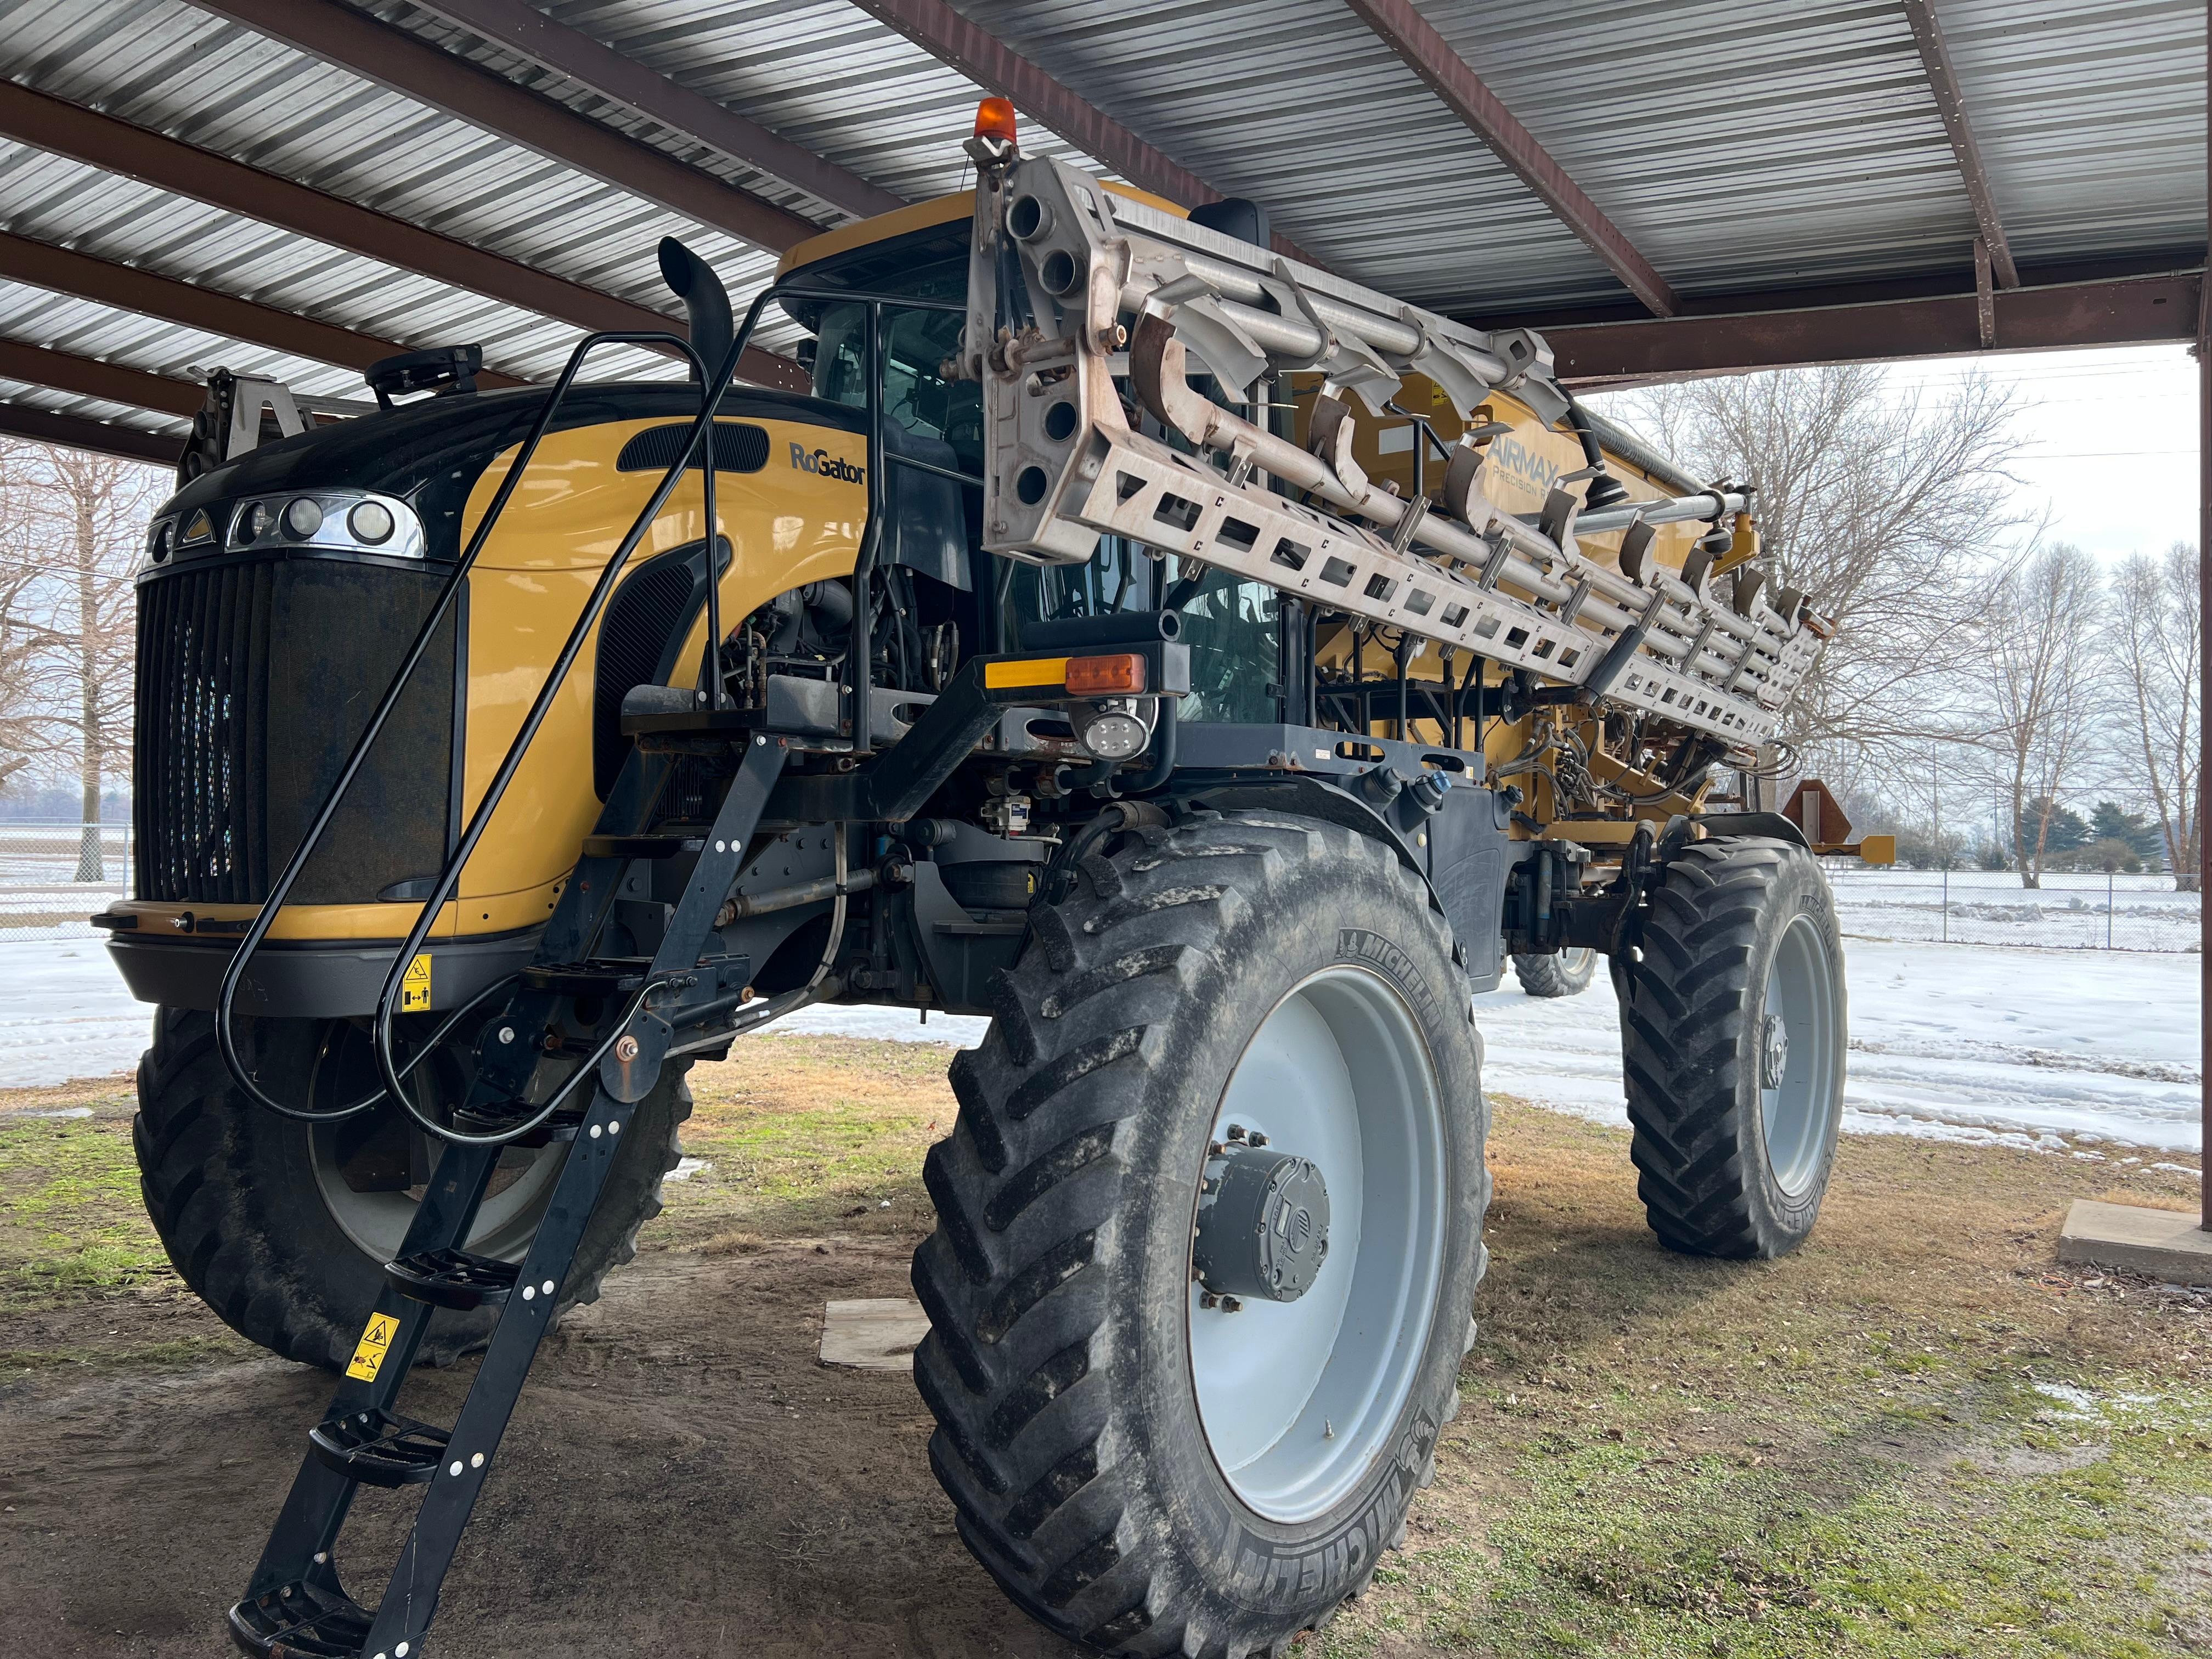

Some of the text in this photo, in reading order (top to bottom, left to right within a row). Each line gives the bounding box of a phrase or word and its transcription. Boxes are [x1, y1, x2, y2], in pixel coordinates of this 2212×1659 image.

[789, 442, 866, 485] RoGator
[1486, 433, 1559, 488] AIRMAX
[1493, 465, 1537, 496] PRECISION
[1807, 896, 1834, 946] MICHELIN
[1360, 933, 1442, 1028] MICHELIN
[1237, 1471, 1403, 1607] MICHELIN
